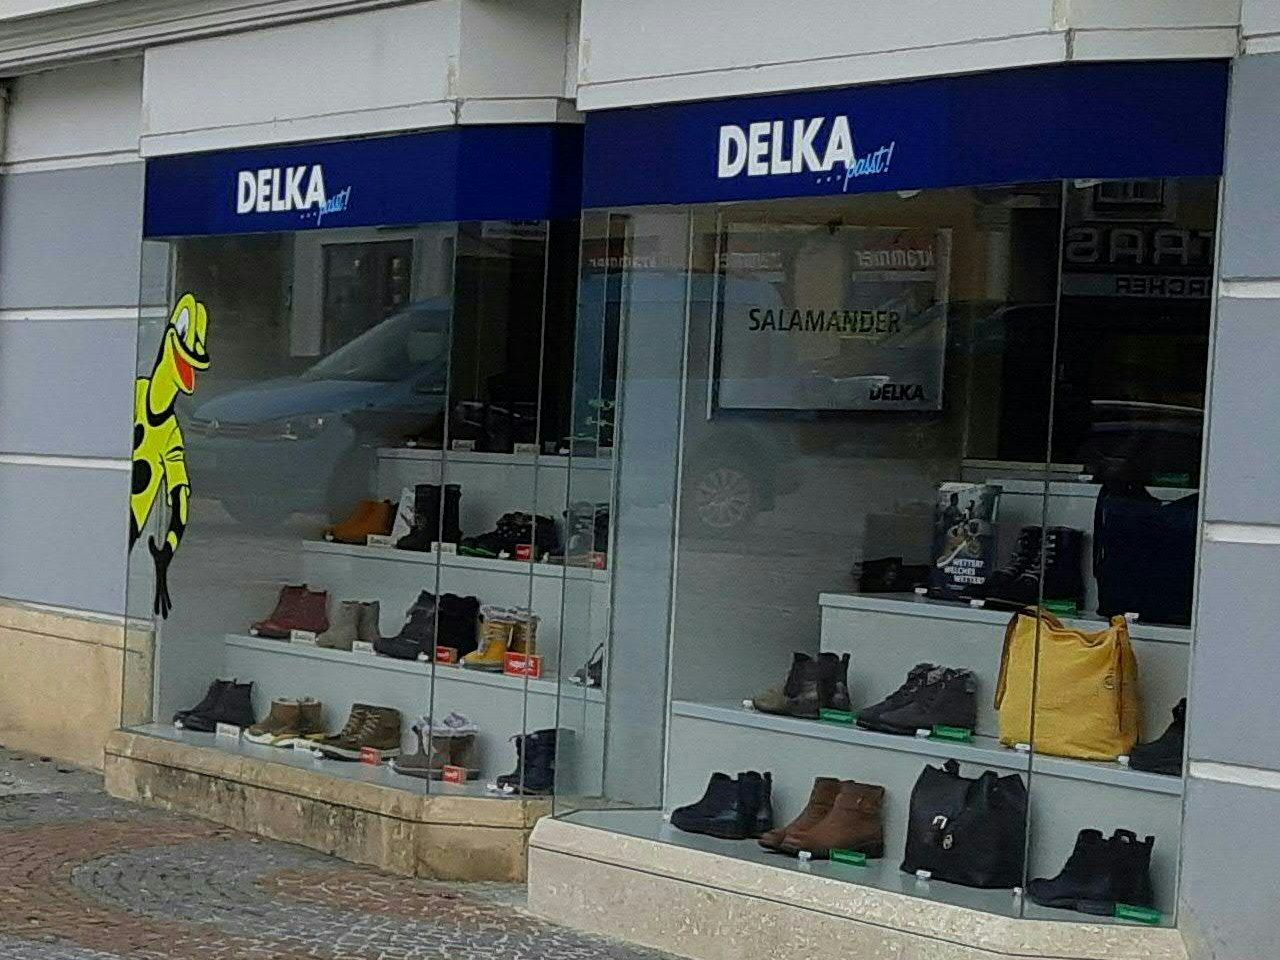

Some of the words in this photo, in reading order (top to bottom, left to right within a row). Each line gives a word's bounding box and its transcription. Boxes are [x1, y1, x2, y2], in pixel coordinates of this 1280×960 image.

[718, 115, 855, 178] DELKA
[236, 164, 326, 214] DELKA
[748, 307, 902, 333] SALAMANDER
[869, 384, 925, 402] DELKA
